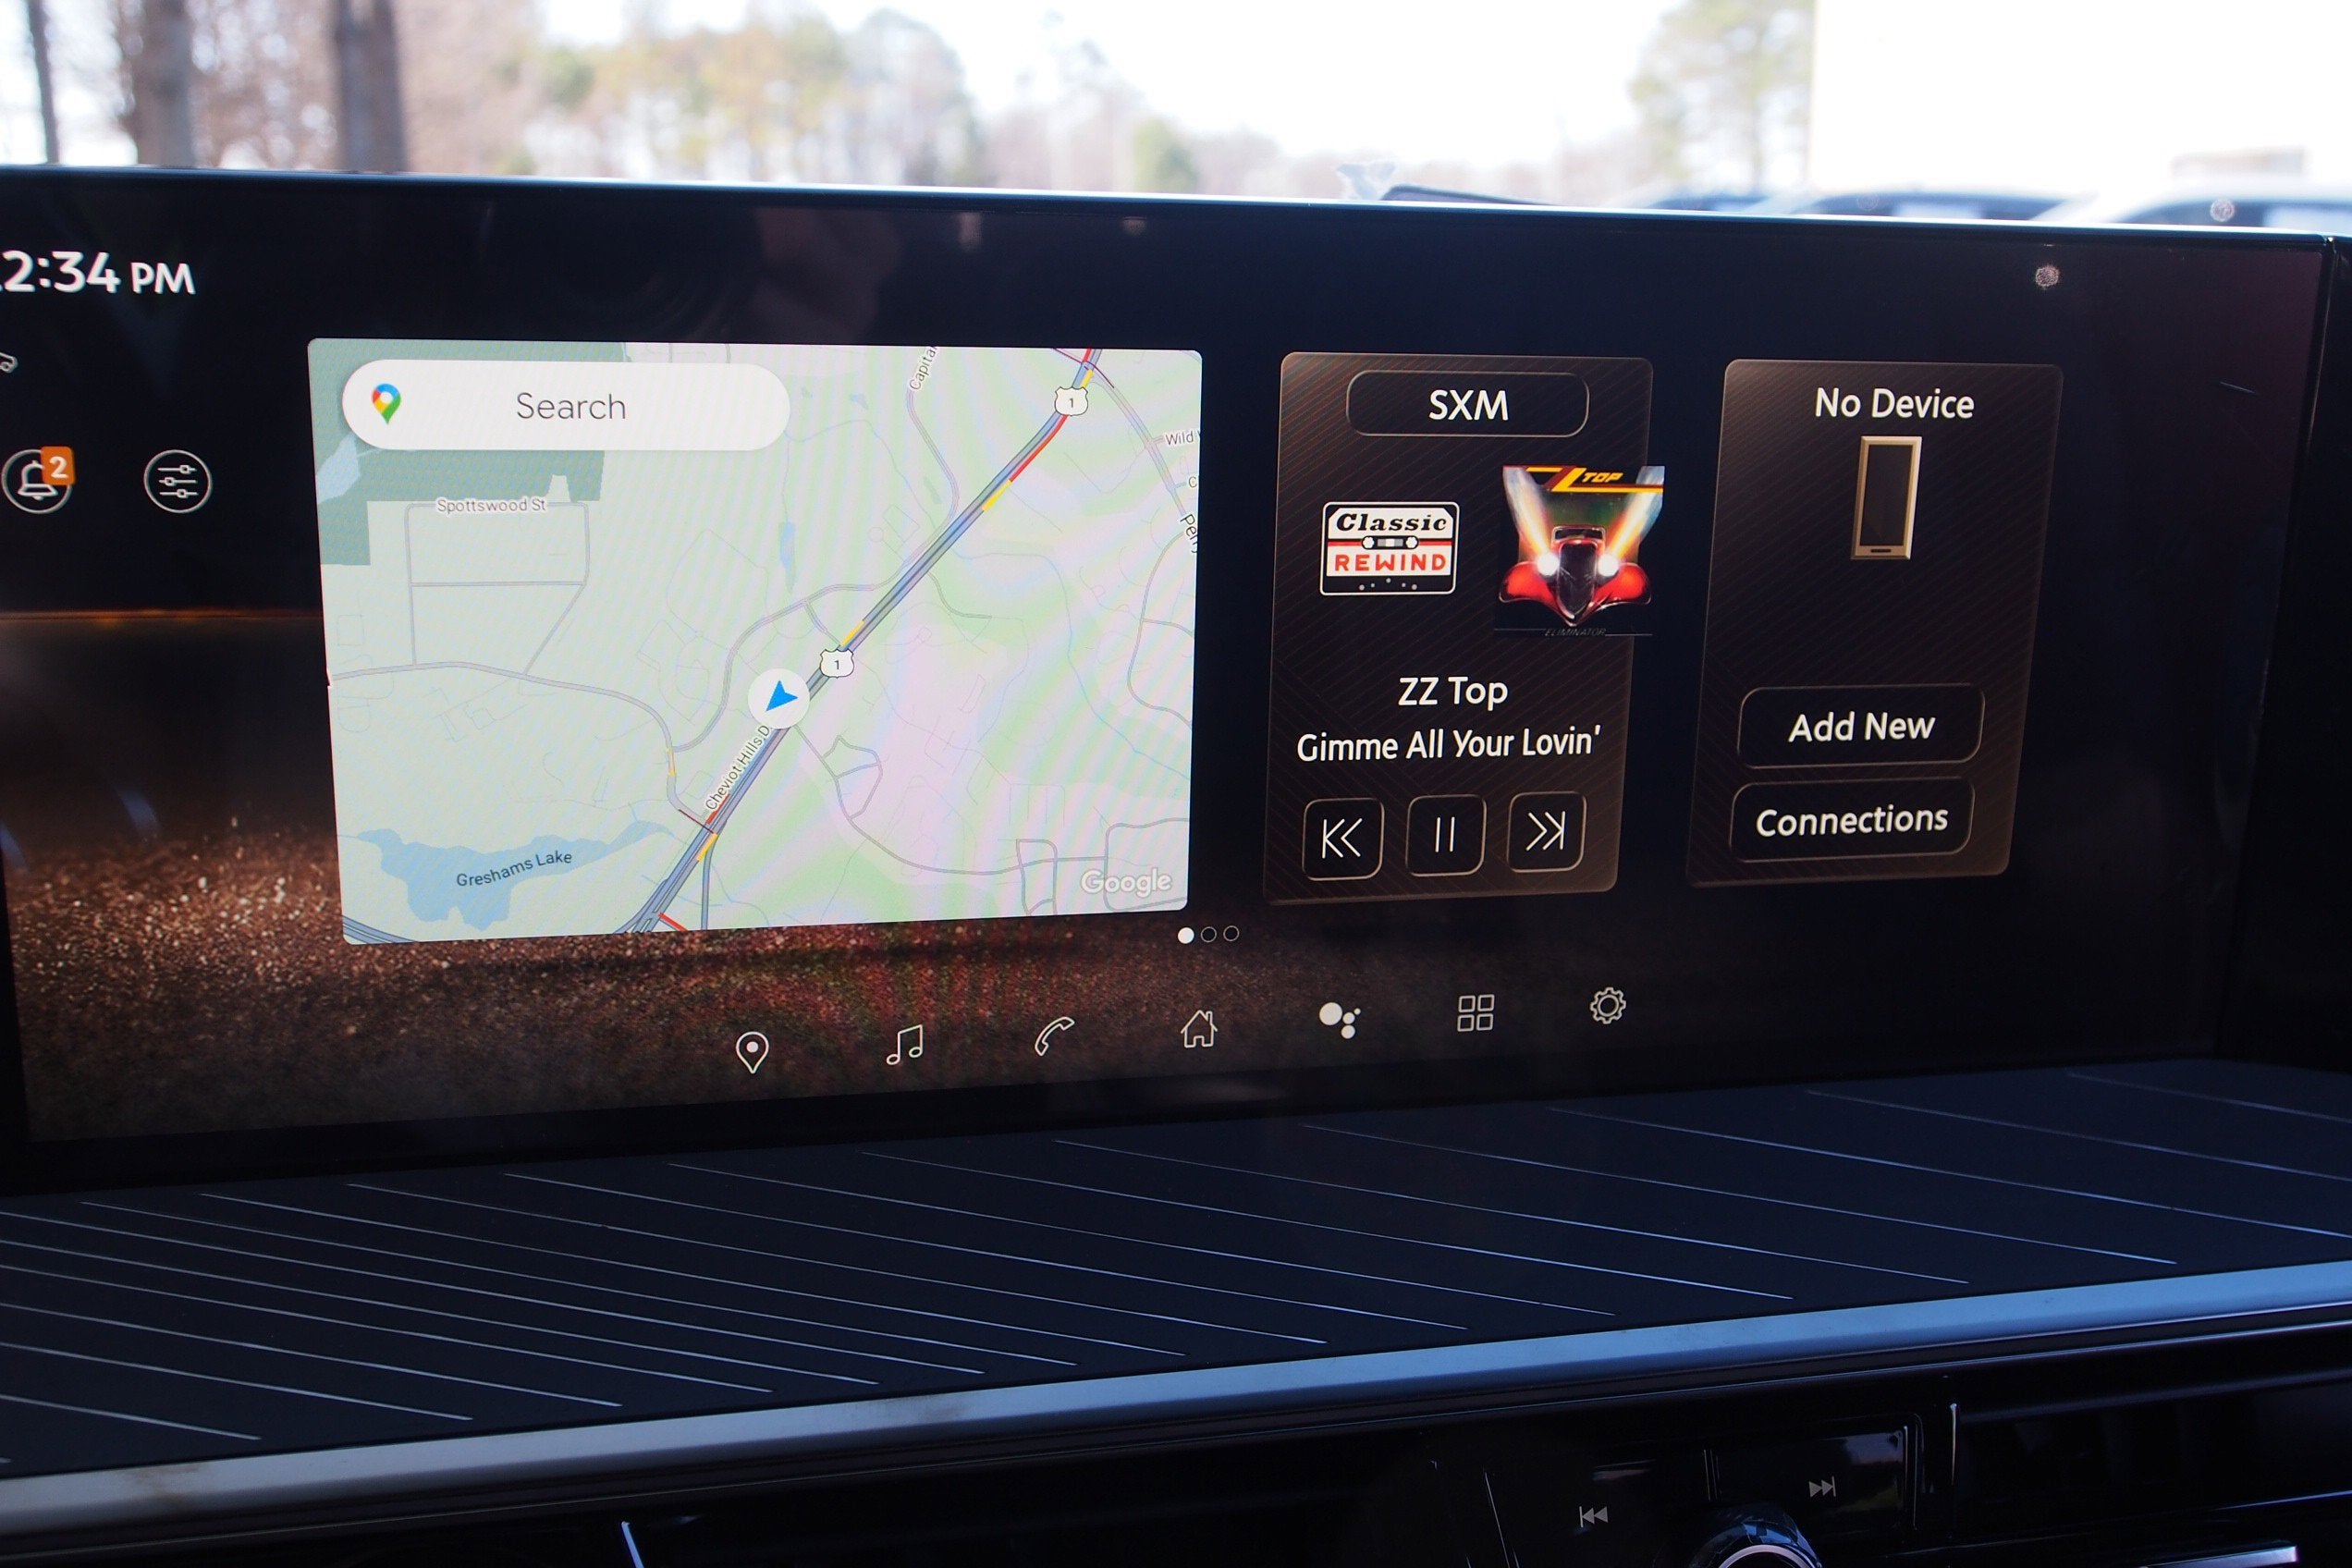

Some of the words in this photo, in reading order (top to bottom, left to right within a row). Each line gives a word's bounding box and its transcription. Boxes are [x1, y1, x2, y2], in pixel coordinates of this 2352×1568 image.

[0, 250, 121, 293] 2:34
[130, 262, 196, 295] PM
[517, 392, 626, 419] Search
[1428, 389, 1509, 421] SXM
[1815, 386, 1860, 418] No
[1871, 387, 1975, 419] Device
[1166, 431, 1194, 446] Wild
[49, 456, 69, 479] 2
[1582, 472, 1623, 483] TOP
[436, 496, 527, 514] Spottswood
[533, 497, 546, 510] St
[1336, 513, 1447, 531] Classic
[1335, 554, 1447, 571] REWIND
[1398, 677, 1439, 705] ZZ
[1448, 676, 1508, 711] Top
[1787, 711, 1855, 742] Add
[1865, 712, 1936, 741] New
[1297, 731, 1398, 762] Gimme
[1406, 729, 1443, 759] All
[1452, 729, 1514, 757] Your
[1523, 724, 1601, 756] Lovin'
[705, 764, 743, 810] Cheviot
[737, 737, 763, 766] Hills
[1756, 803, 1948, 837] Connections
[457, 859, 533, 887] Greshams
[535, 851, 572, 867] Lake
[1081, 867, 1172, 899] Google
